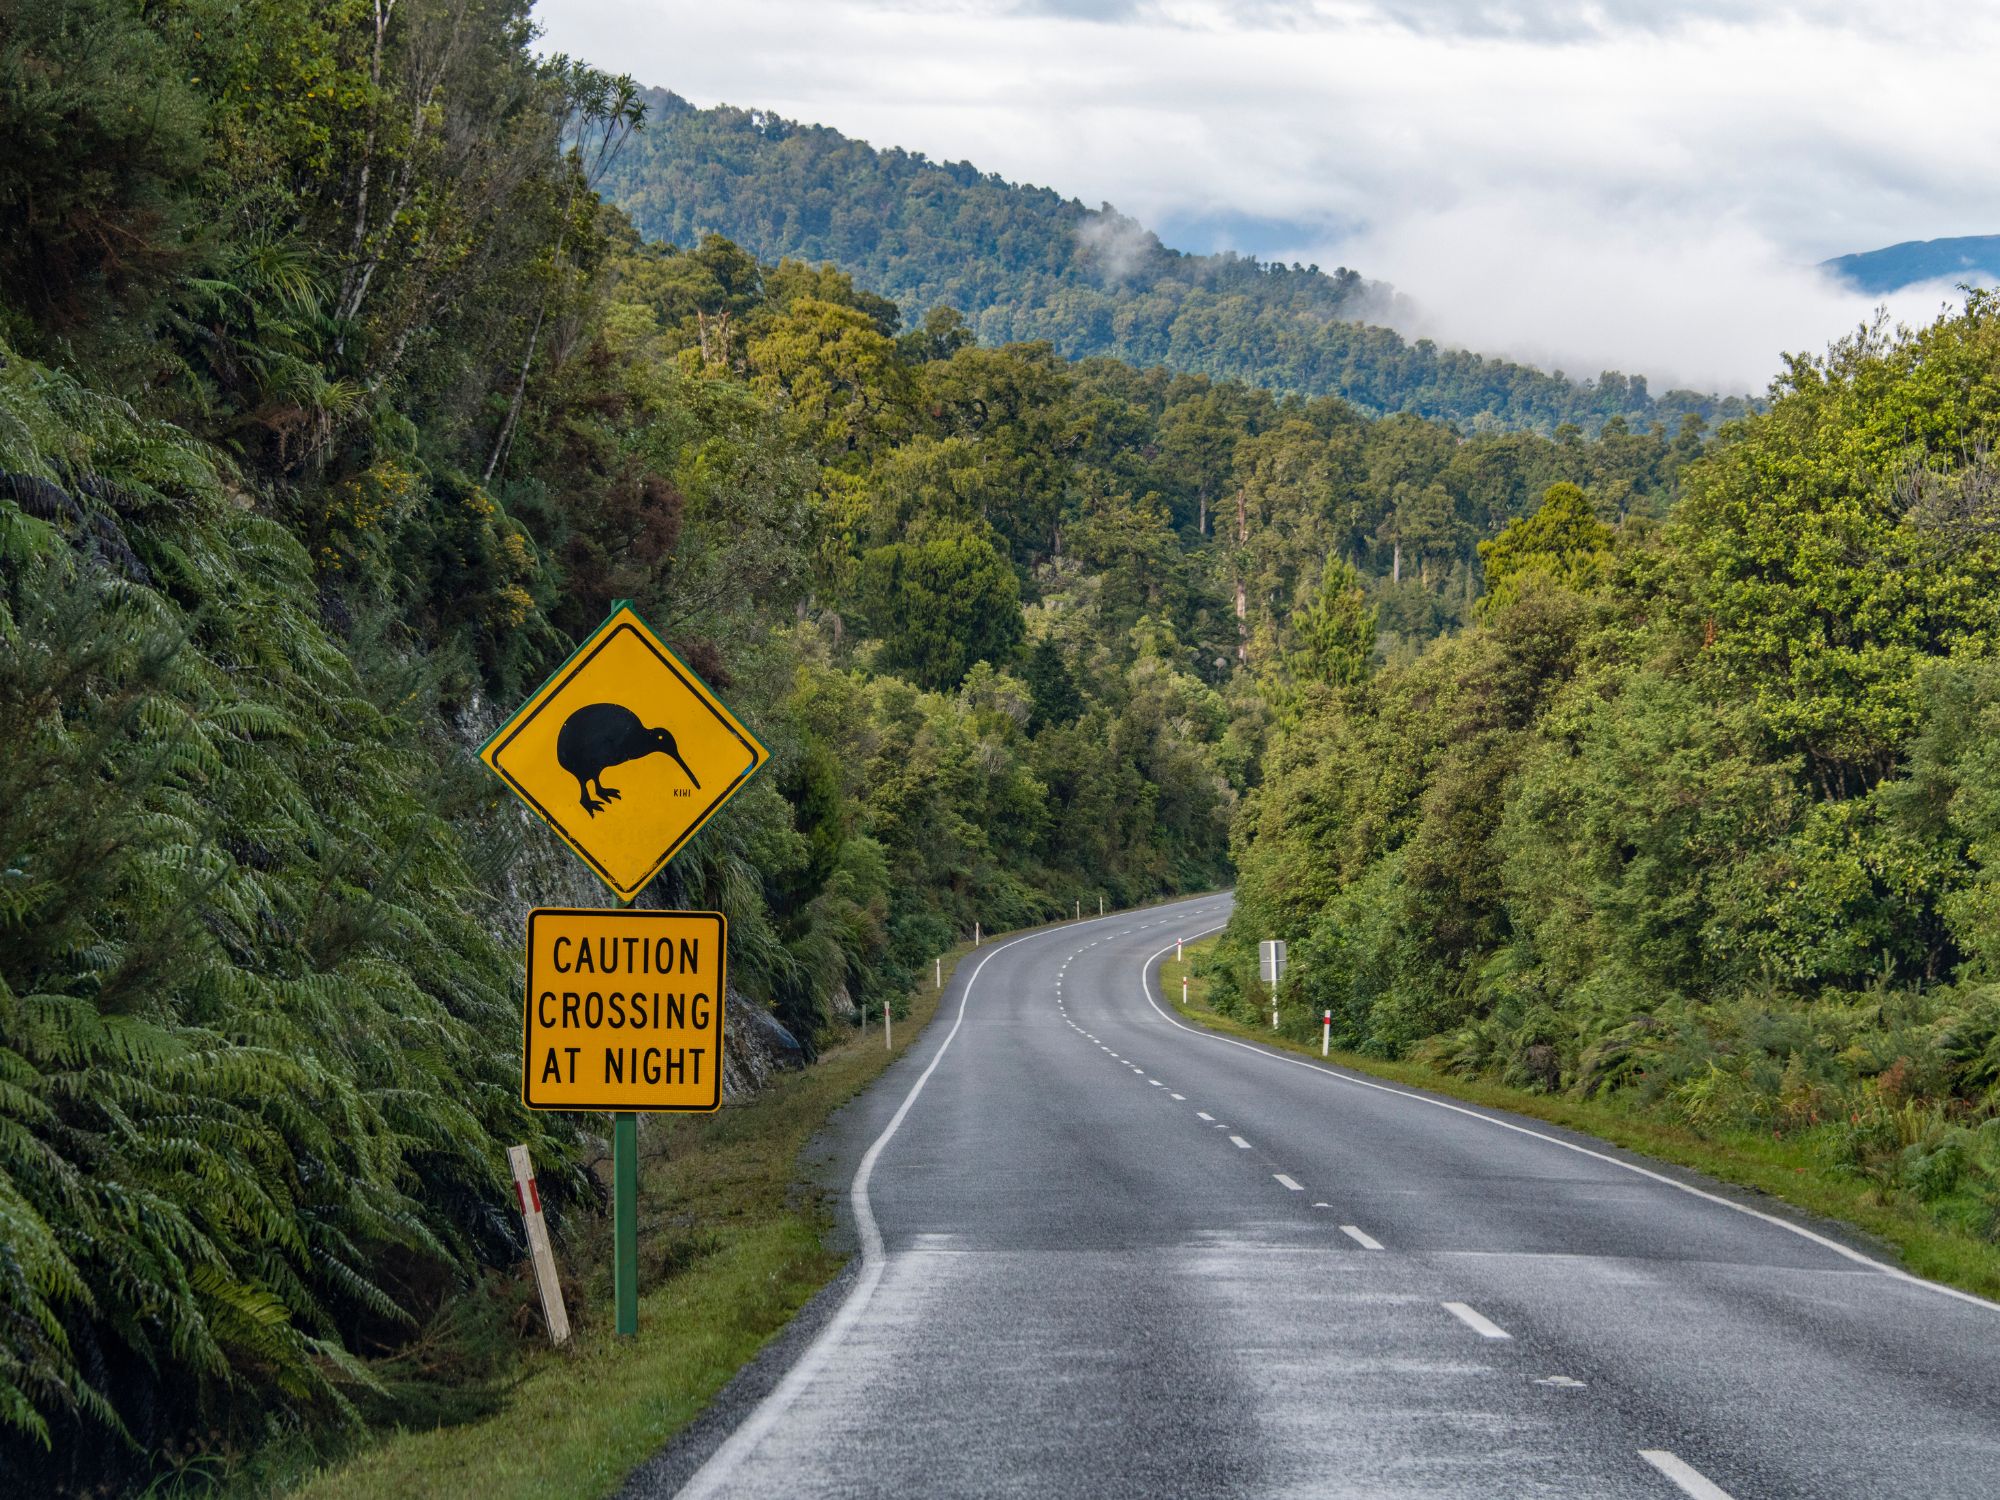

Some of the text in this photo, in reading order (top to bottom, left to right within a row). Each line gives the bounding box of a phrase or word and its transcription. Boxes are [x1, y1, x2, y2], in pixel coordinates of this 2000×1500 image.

[673, 788, 691, 798] KIWI
[553, 937, 699, 974] CAUTION
[538, 991, 710, 1030] CROSSING
[541, 1047, 706, 1085] AT NIGHT
